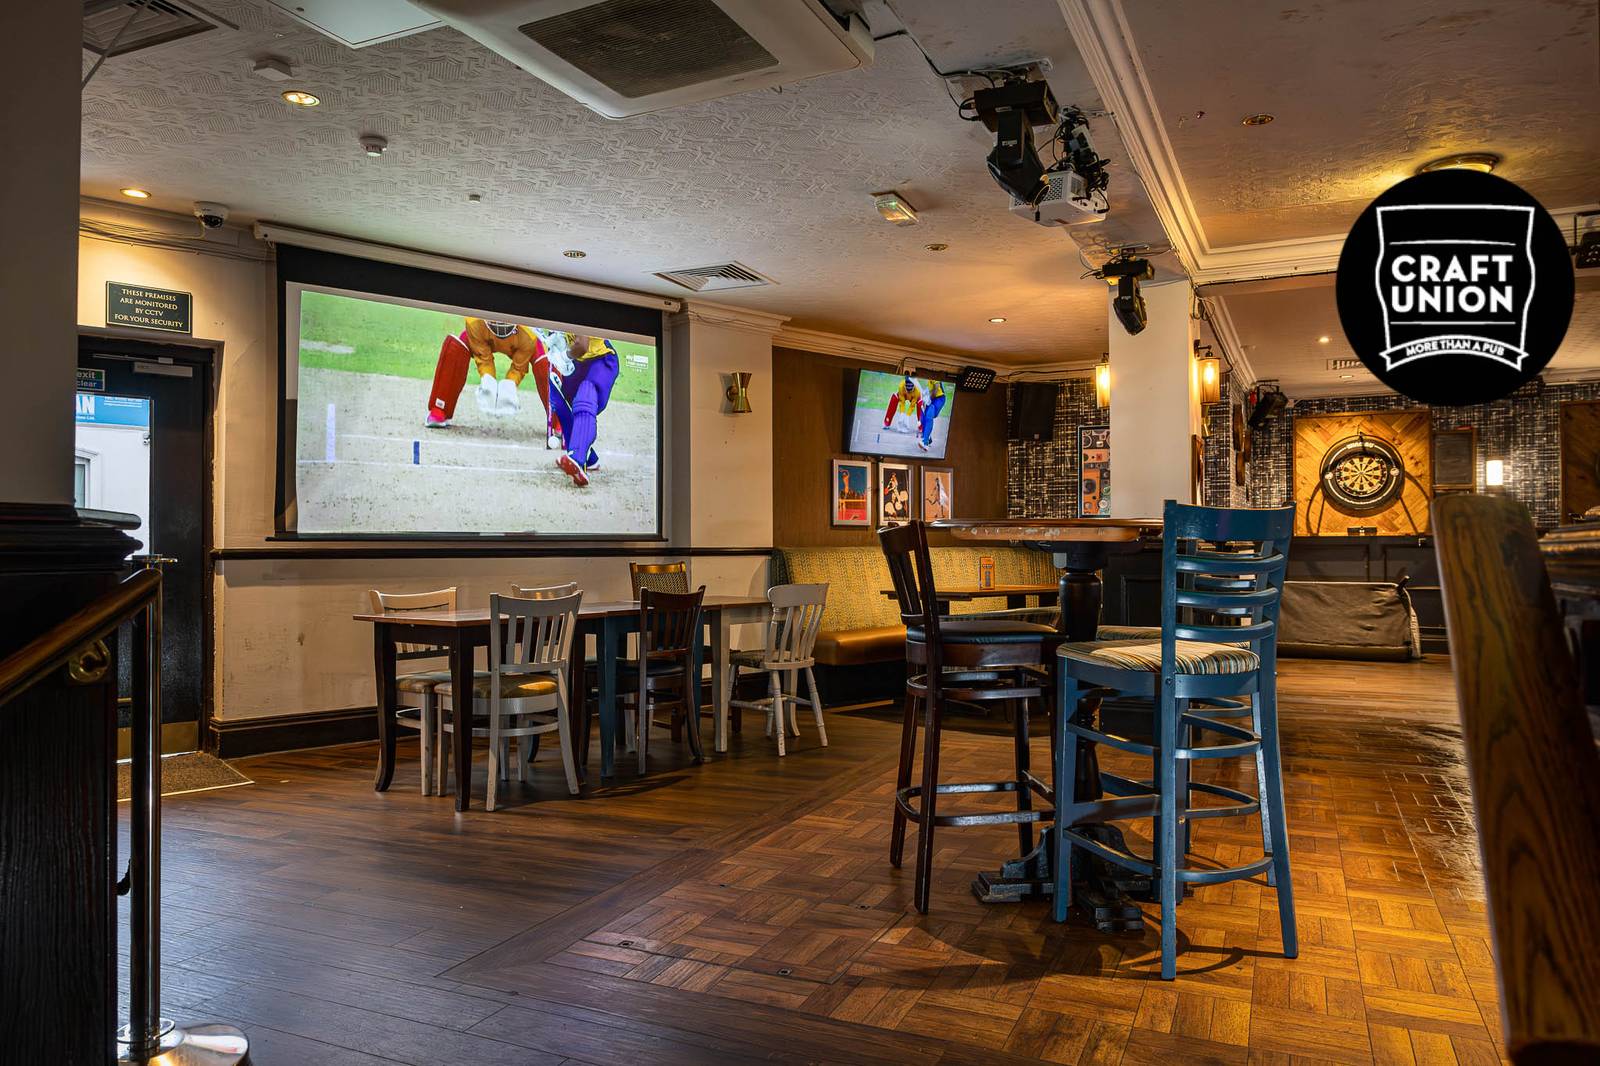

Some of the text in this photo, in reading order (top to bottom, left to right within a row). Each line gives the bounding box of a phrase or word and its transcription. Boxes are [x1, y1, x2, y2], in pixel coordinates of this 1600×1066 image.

[121, 288, 177, 302] THESE PREMISES
[134, 298, 178, 311] MONITORED
[144, 309, 164, 317] CCTV
[114, 313, 183, 328] FOR YOUR SECURITY
